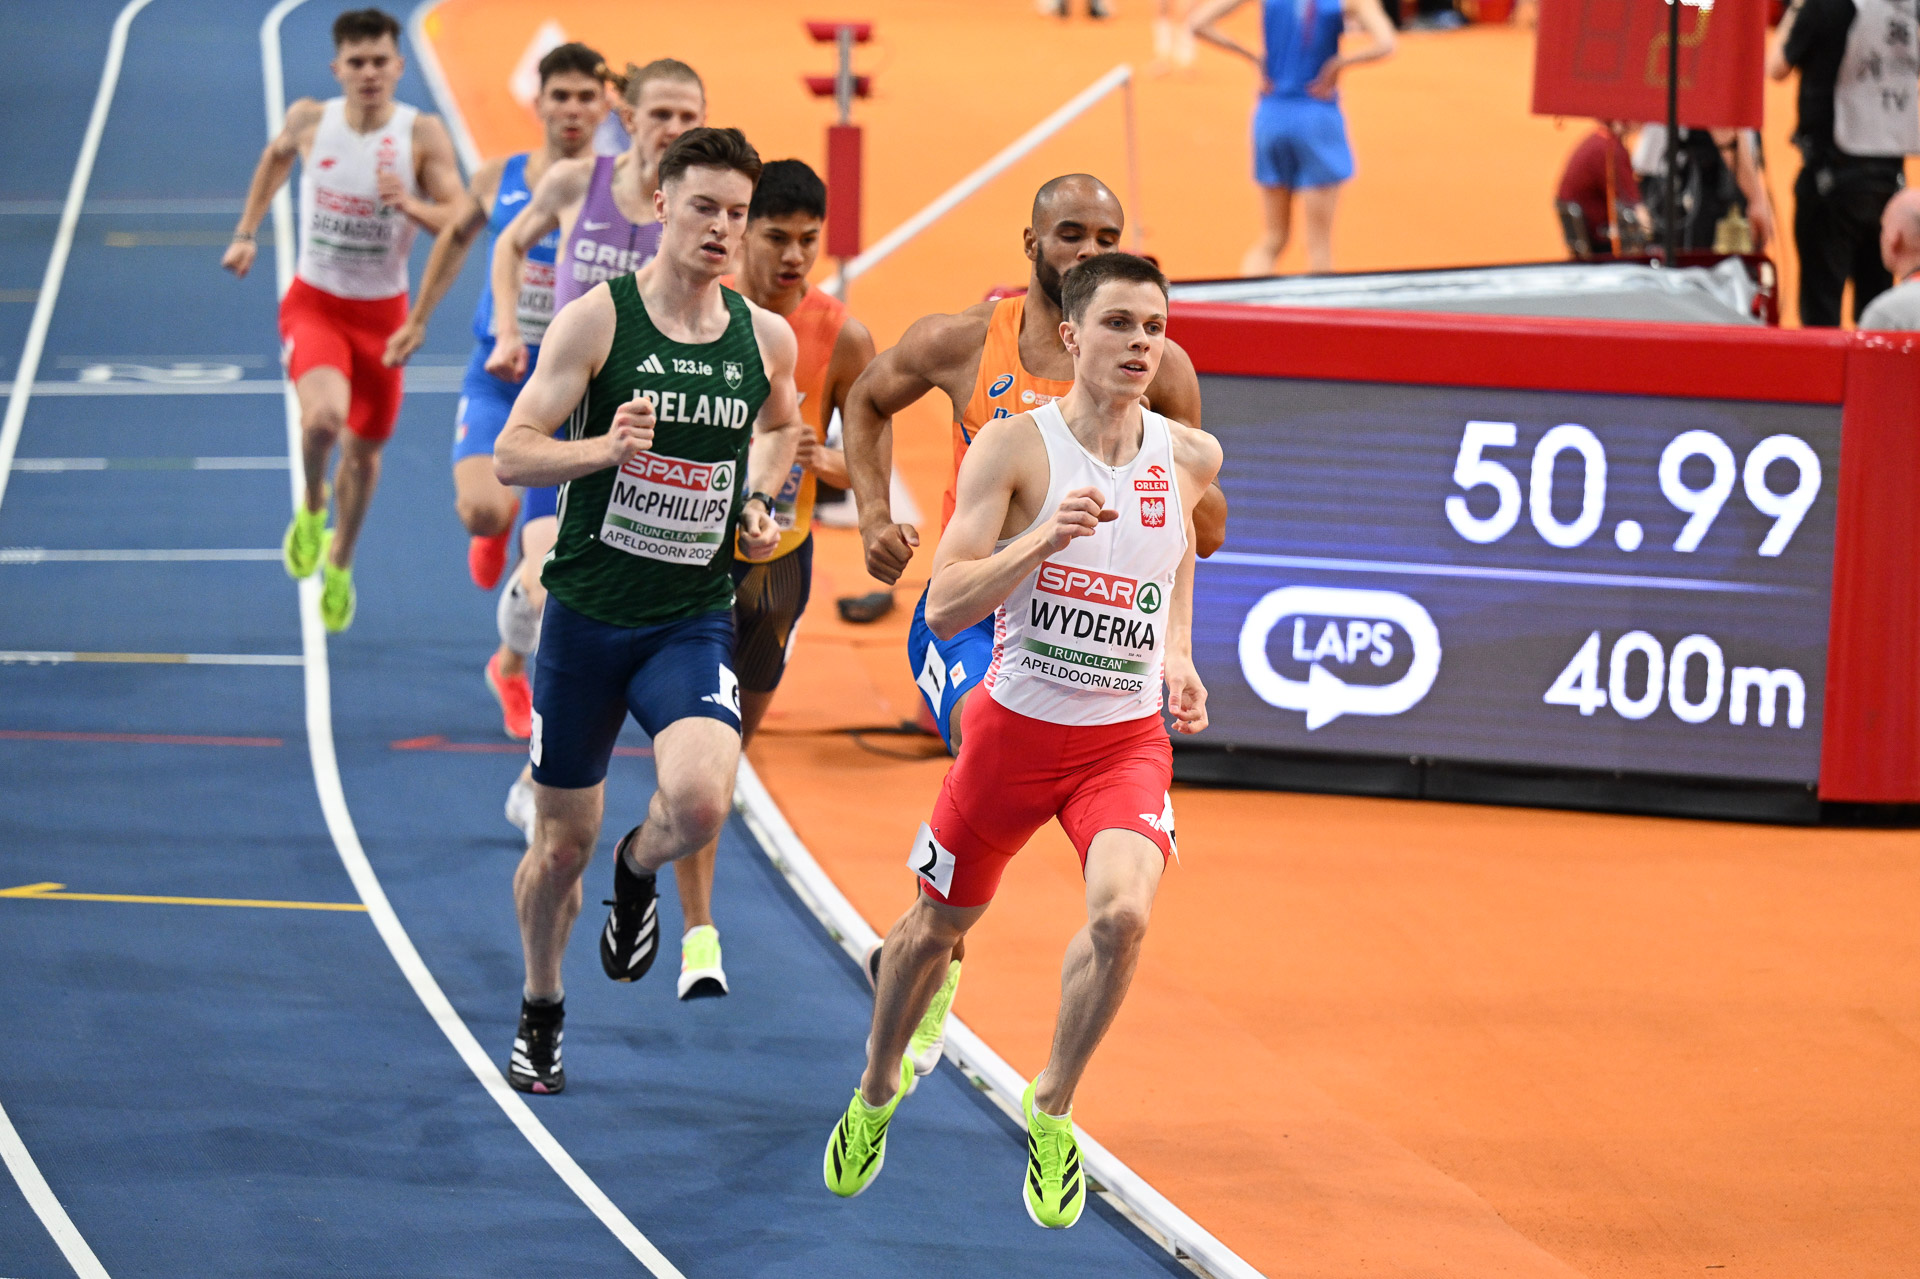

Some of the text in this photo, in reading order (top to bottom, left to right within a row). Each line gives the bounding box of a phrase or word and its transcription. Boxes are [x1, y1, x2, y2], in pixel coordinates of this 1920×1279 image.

[672, 359, 713, 376] 123.ie
[624, 454, 710, 488] SPAR
[1135, 481, 1167, 490] ORLEN
[1445, 420, 1822, 557] 50.99
[613, 481, 728, 523] McPHILLIPS
[604, 530, 690, 558] APELDOORN
[635, 524, 661, 538] RUN
[1040, 566, 1134, 605] SPAR
[1031, 598, 1155, 651] WYDERKA
[1292, 616, 1395, 667] LAPS
[1048, 646, 1053, 656] I
[1054, 647, 1083, 663] RUN
[1020, 656, 1144, 692] APELDOORN 2025
[1543, 630, 1806, 729] 400m
[918, 840, 938, 882] 2
